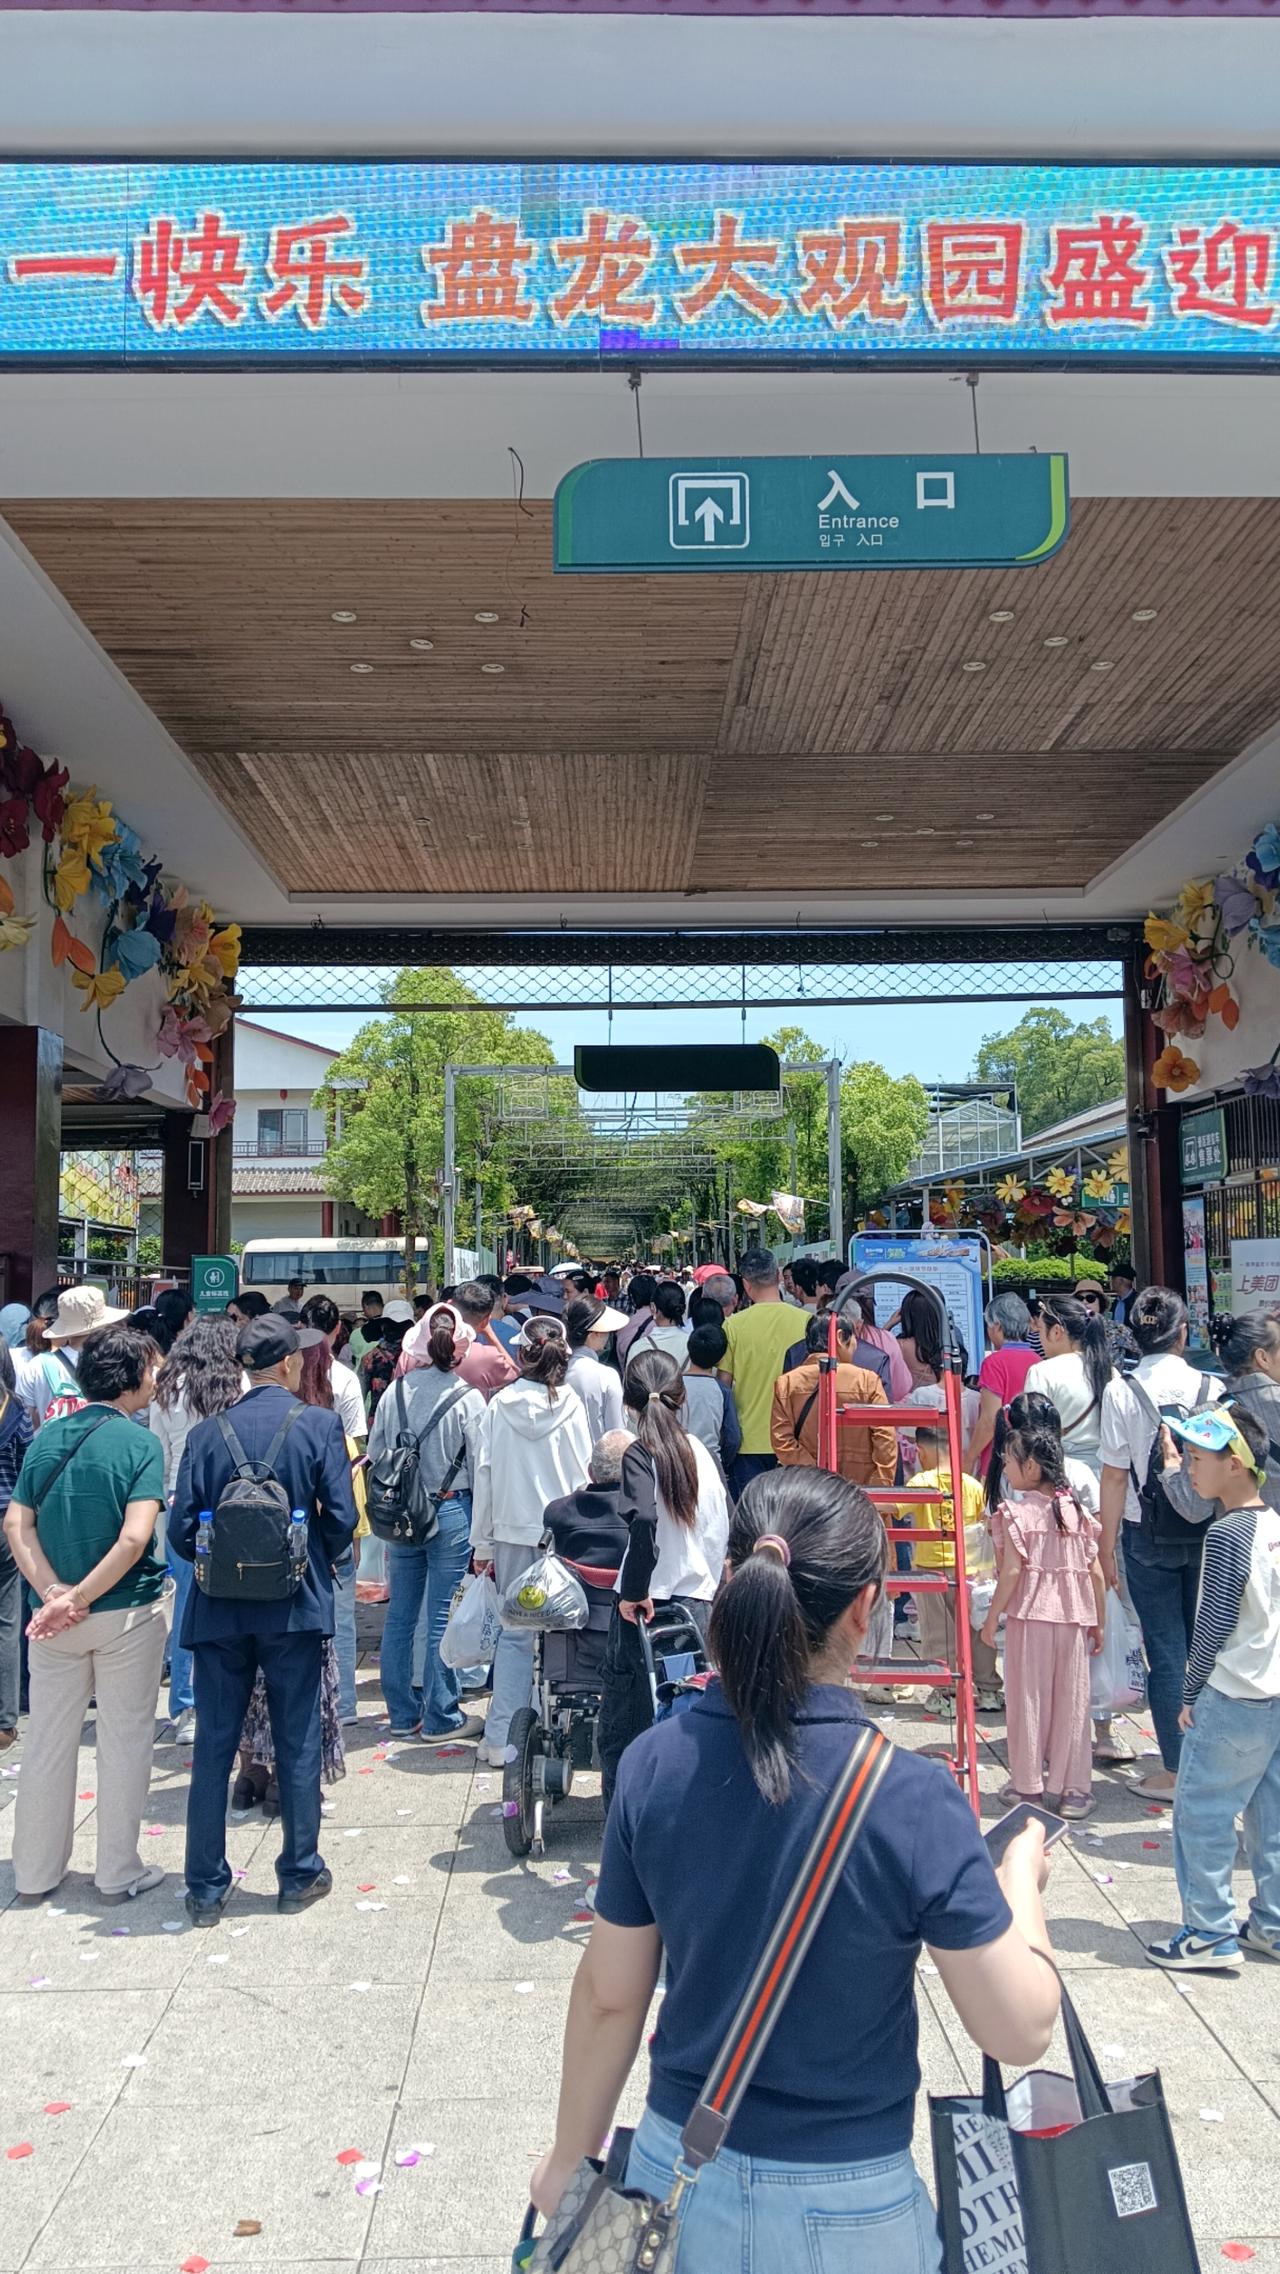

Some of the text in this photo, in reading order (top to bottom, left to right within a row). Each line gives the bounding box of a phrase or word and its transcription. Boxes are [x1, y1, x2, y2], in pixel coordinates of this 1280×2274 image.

[817, 470, 955, 511] 入口
[819, 515, 899, 529] Entrance
[819, 534, 845, 547] 입구
